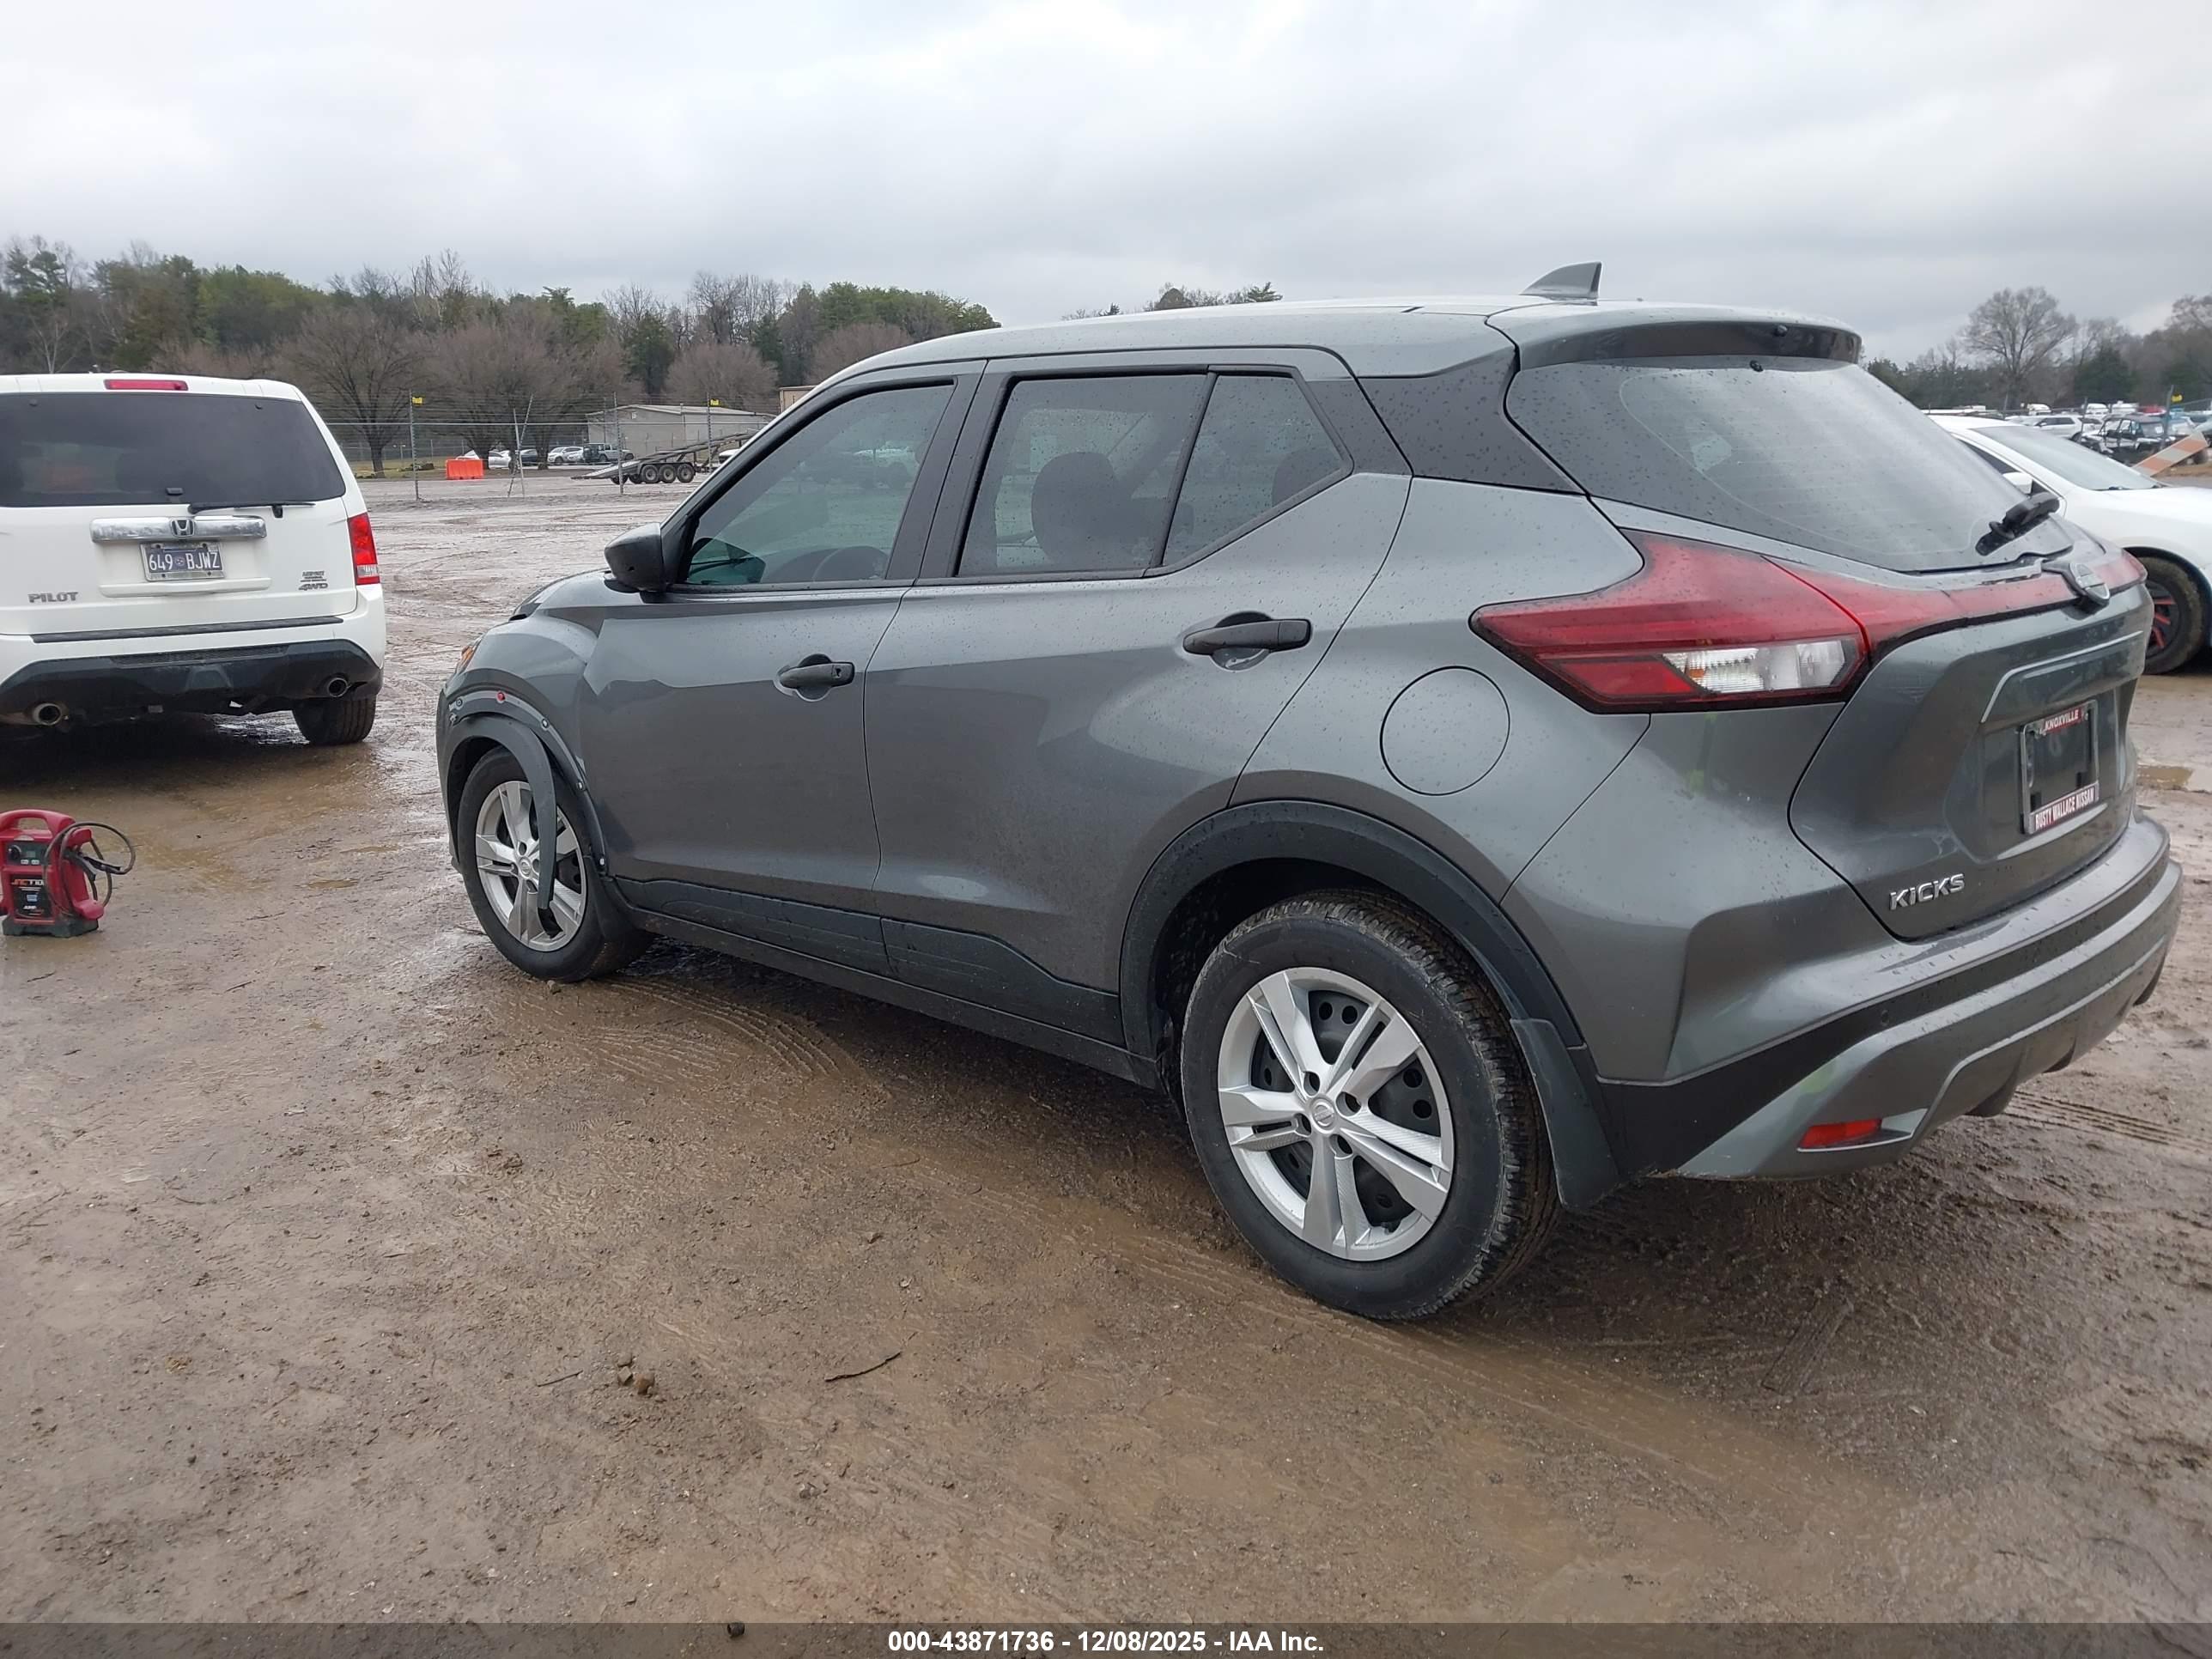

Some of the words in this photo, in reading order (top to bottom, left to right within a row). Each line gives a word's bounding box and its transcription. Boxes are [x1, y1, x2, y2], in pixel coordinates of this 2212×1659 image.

[149, 553, 173, 572] 649
[185, 552, 221, 570] BJWZ
[27, 592, 79, 604] PILOT
[2045, 708, 2080, 731] KNOXVILLE
[2035, 807, 2052, 831] RUSTY
[2052, 796, 2076, 822] WALLACE
[2075, 787, 2094, 811] NISSAN
[1889, 873, 1965, 910] KICKS
